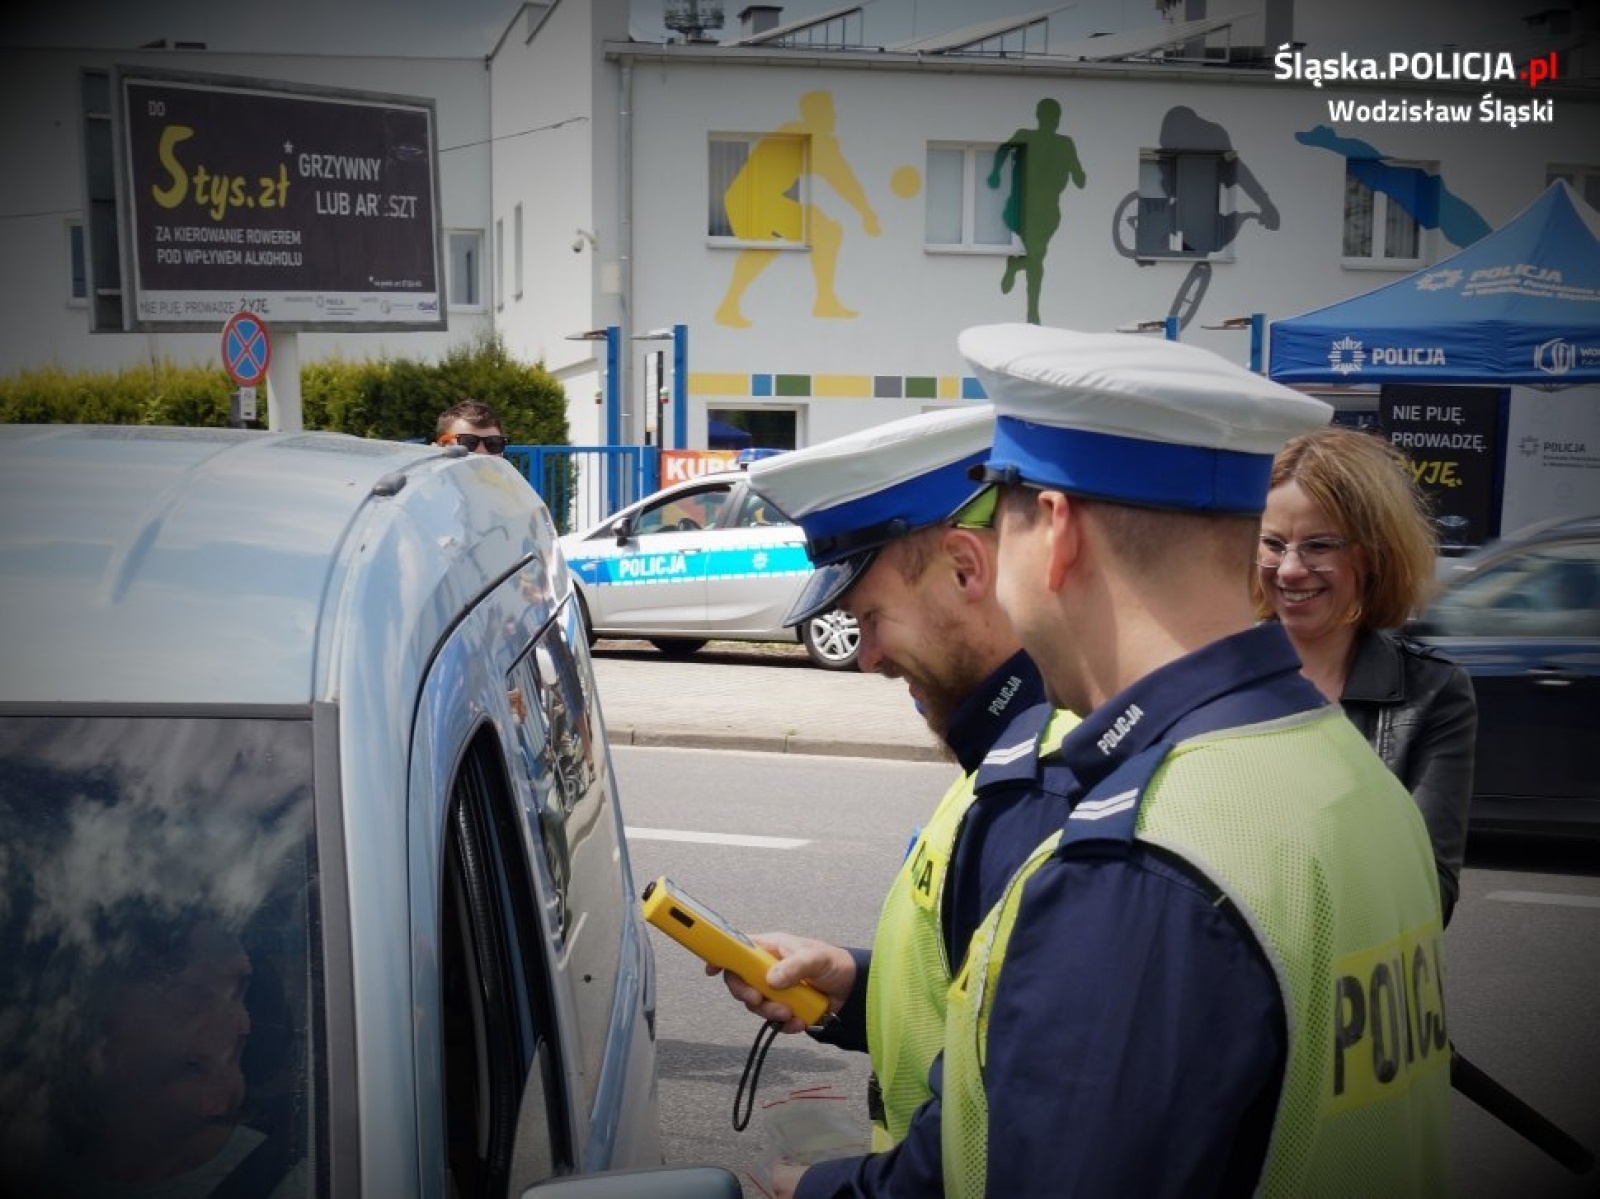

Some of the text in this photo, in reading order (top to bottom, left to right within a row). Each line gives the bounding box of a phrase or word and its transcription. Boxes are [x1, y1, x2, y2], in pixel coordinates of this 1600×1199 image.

[148, 101, 166, 116] DO
[299, 153, 381, 181] GRZYWNY
[316, 191, 418, 219] LUB ARSZT
[155, 226, 302, 245] ZA KIEROWANIE ROWEREM
[157, 249, 302, 266] POD WPŁYWEM ALKOHOLU
[1371, 347, 1446, 366] POLICJA
[1393, 405, 1421, 420] NIE
[1543, 441, 1586, 453] POLICJA
[1399, 457, 1463, 487] YJĘ.
[620, 556, 686, 578] POLICJA
[988, 675, 1022, 717] POLICJA
[1097, 703, 1145, 757] POLICJA
